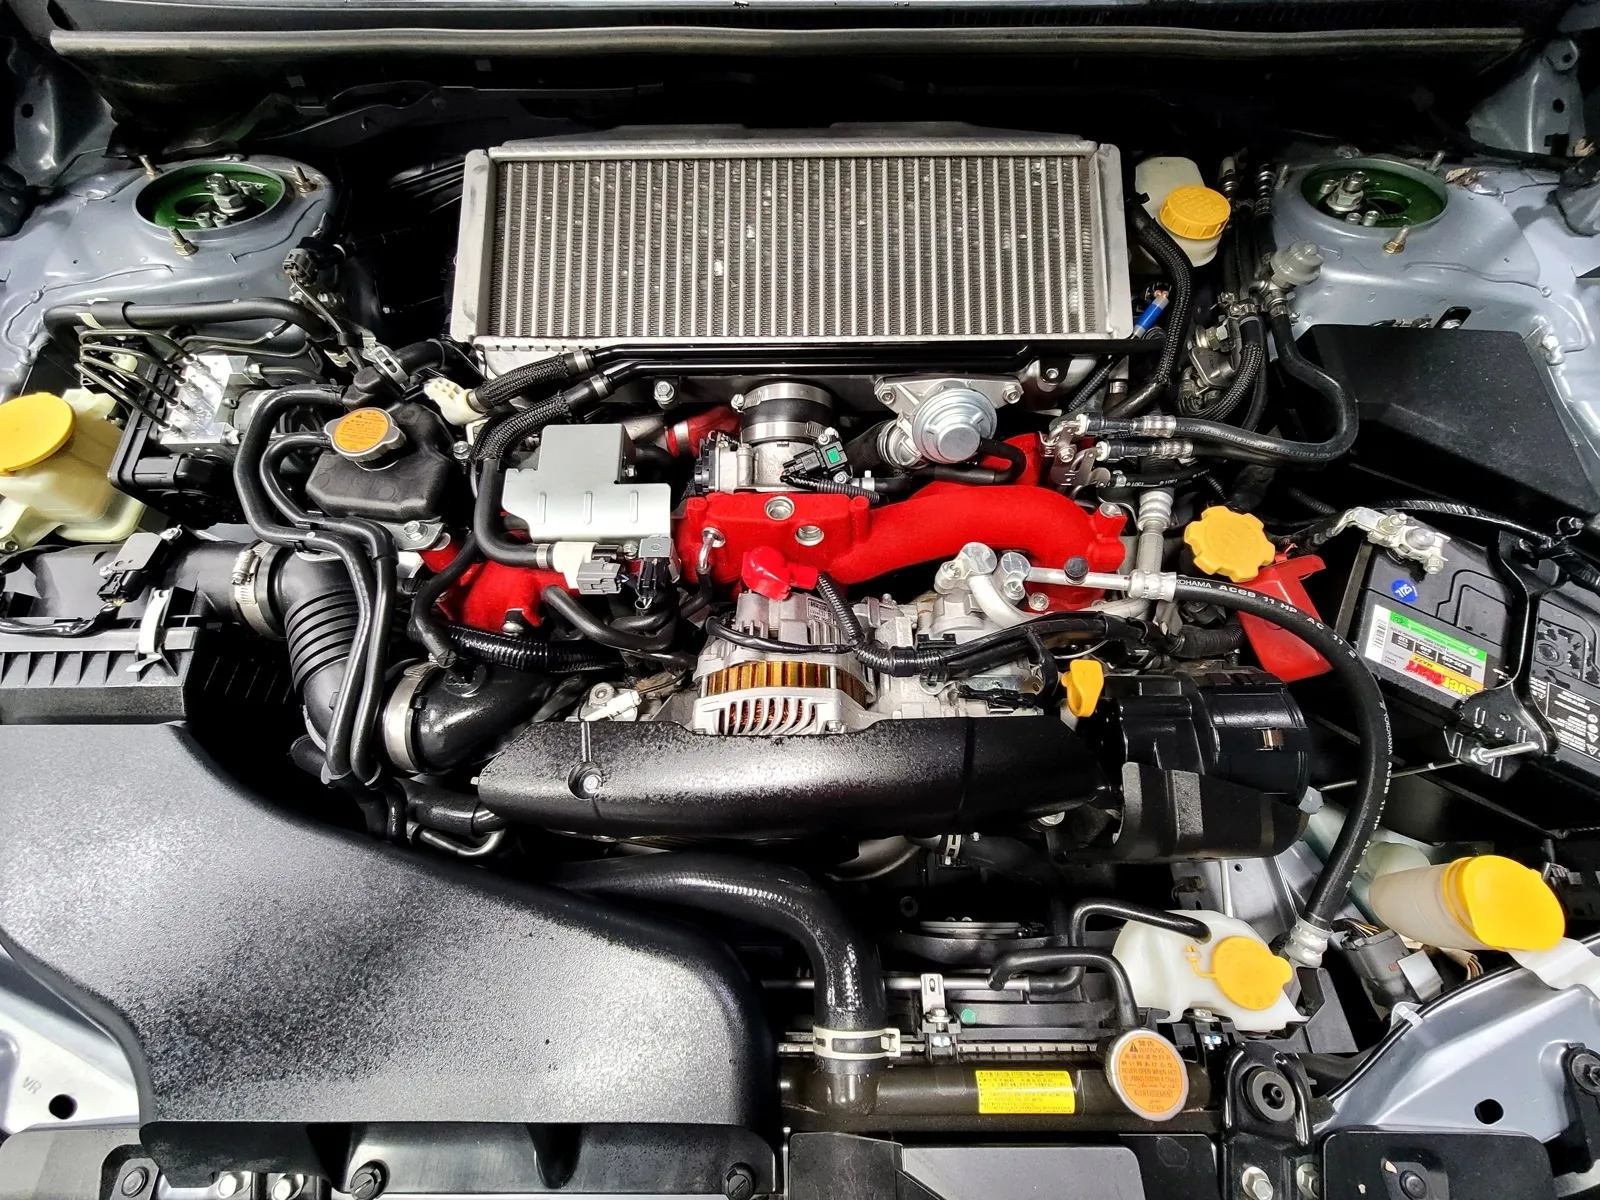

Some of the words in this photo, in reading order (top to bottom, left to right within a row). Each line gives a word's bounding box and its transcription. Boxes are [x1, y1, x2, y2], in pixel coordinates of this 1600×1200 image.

[1280, 602, 1299, 614] HP
[1306, 616, 1325, 631] AC
[1414, 656, 1433, 668] MAXX
